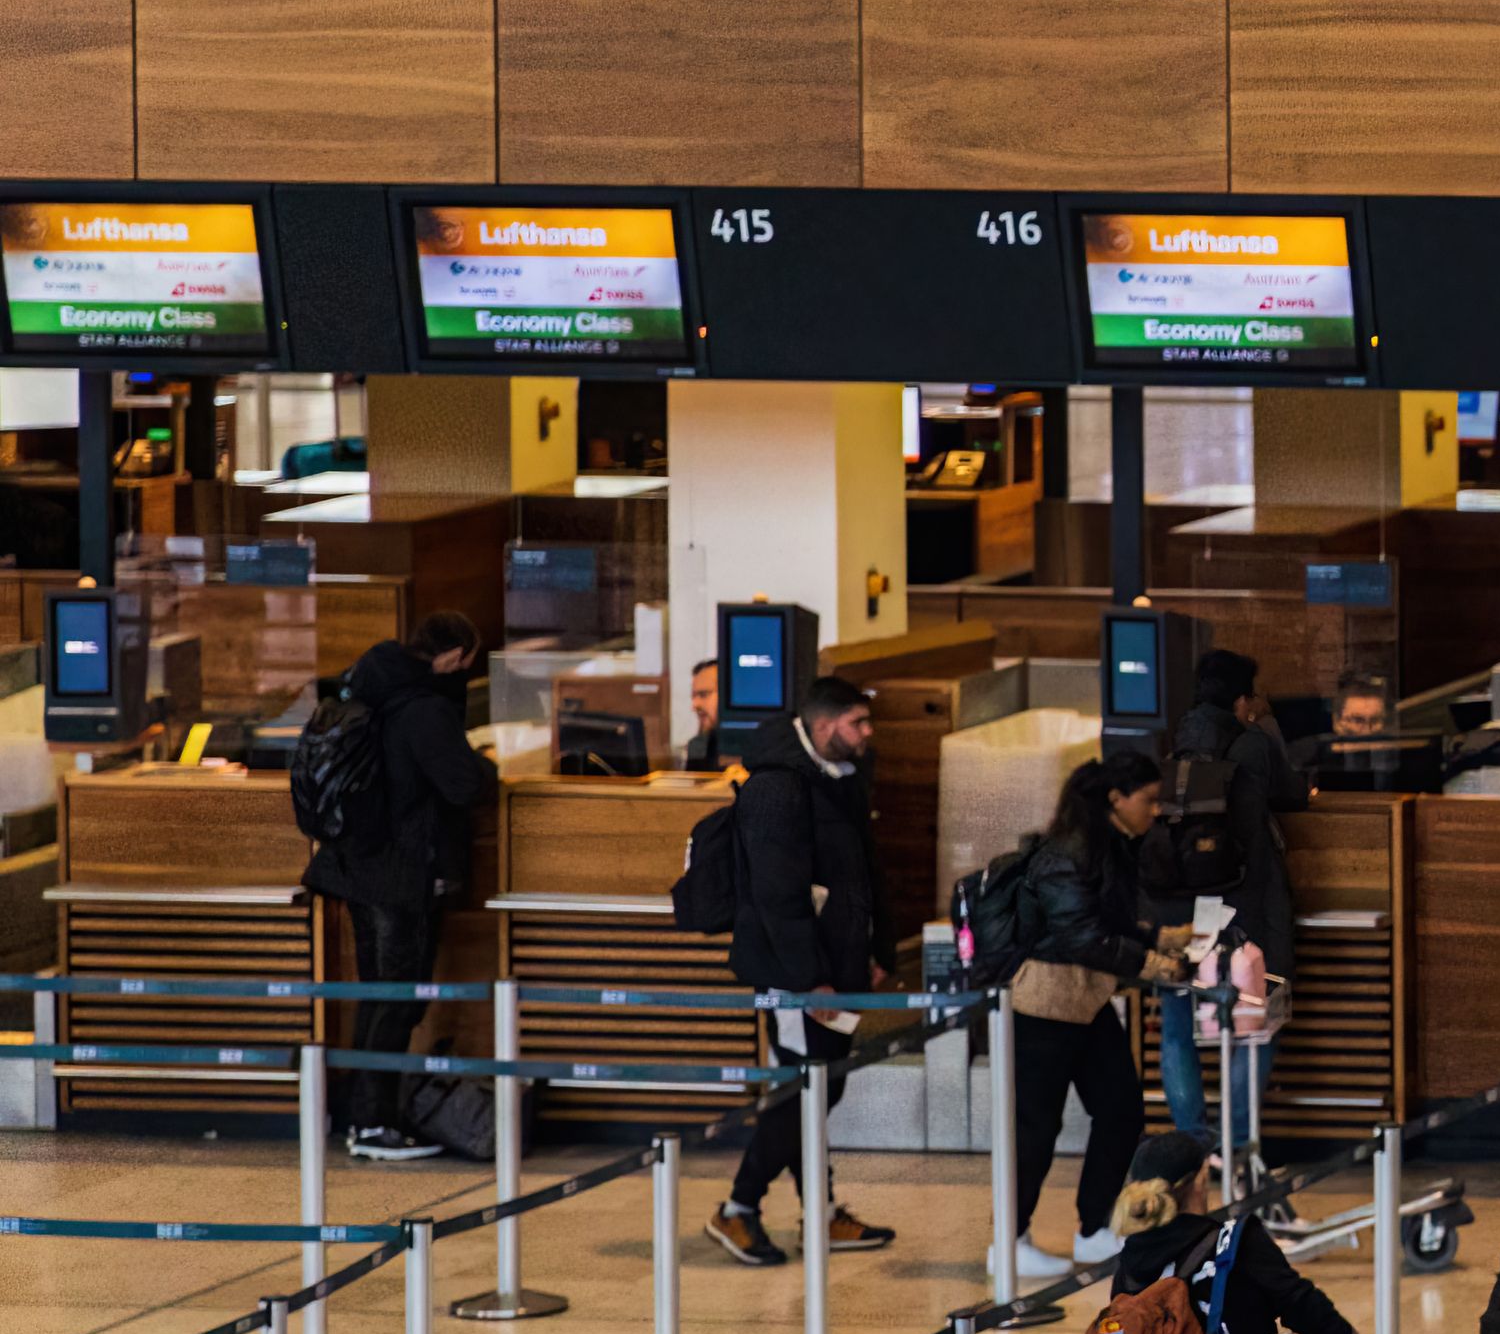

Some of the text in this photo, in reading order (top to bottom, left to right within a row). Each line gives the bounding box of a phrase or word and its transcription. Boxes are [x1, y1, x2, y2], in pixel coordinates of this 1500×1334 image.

[63, 217, 189, 242] Lufthansa
[480, 222, 607, 246] Lufthansa
[710, 209, 774, 244] 415
[976, 210, 1042, 245] 416
[1149, 229, 1279, 254] Lufthansa
[60, 306, 217, 331] Economy Class
[475, 310, 633, 336] Economy Class
[1144, 319, 1304, 345] Economy Class
